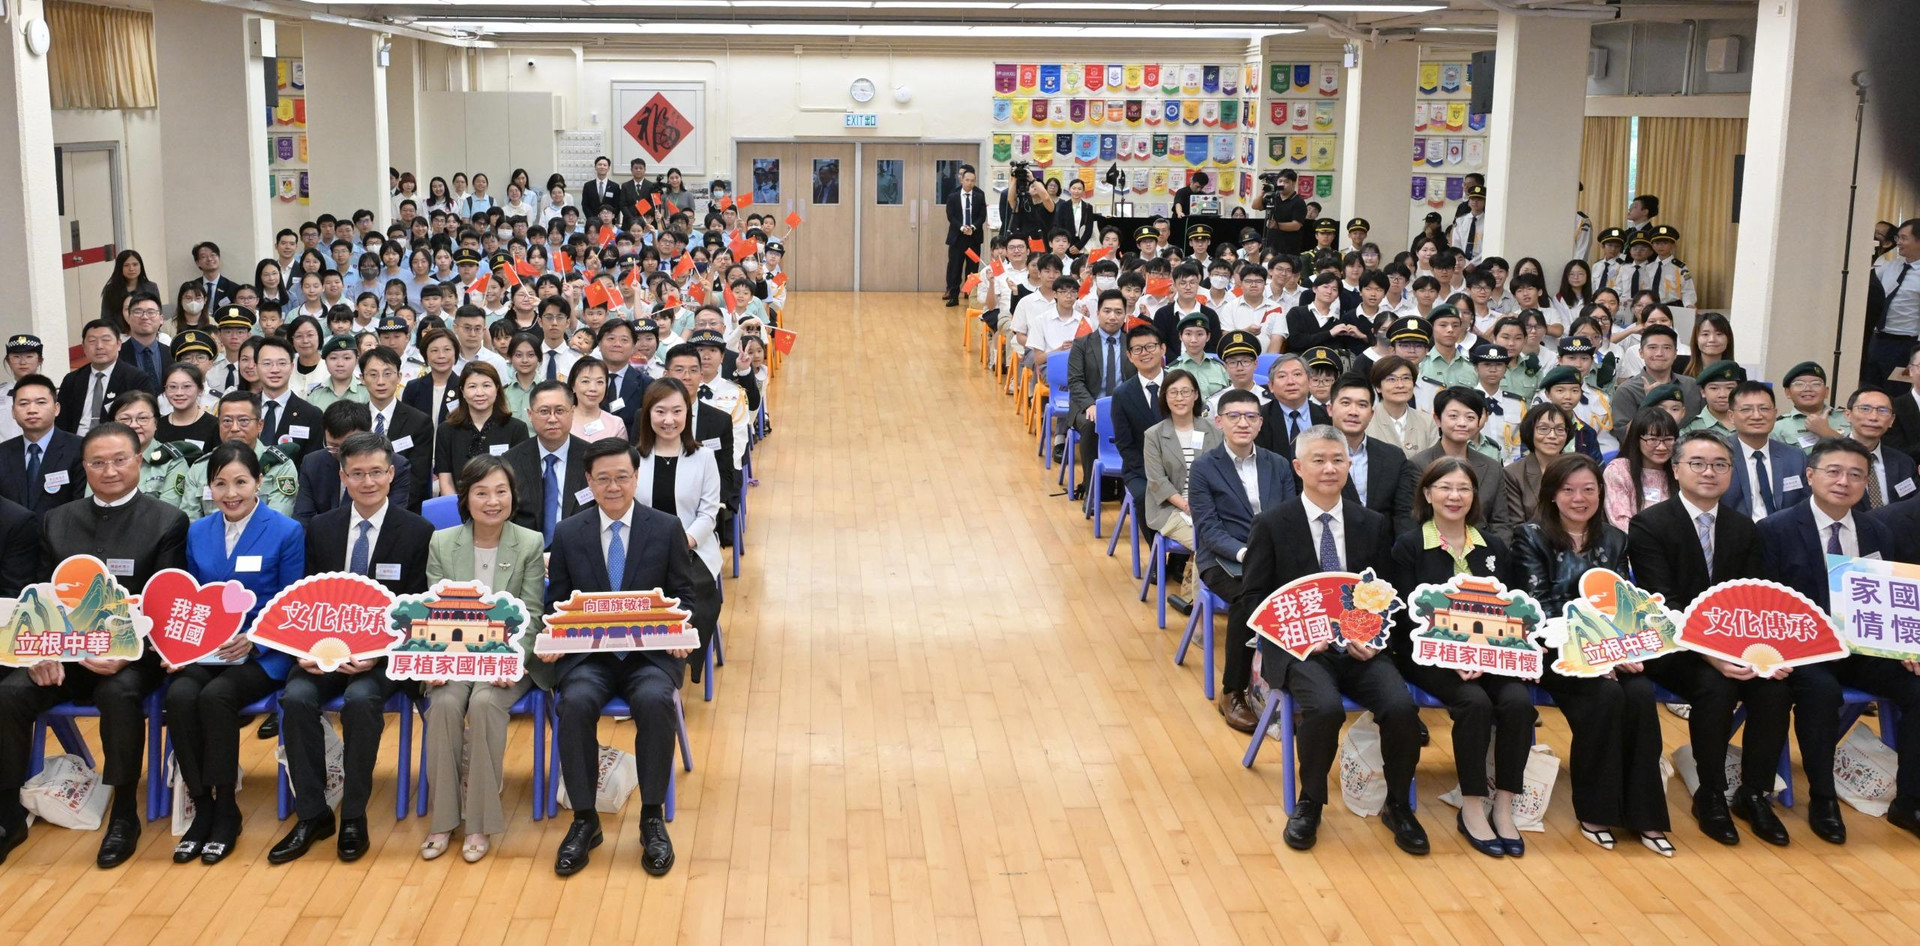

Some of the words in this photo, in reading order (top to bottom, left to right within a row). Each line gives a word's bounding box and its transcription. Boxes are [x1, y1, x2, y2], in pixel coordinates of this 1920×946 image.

[846, 115, 864, 126] EXIT
[865, 115, 876, 126] 出口
[584, 598, 651, 613] 向國旗敬禮
[1272, 587, 1327, 622] 我愛
[1850, 576, 1920, 611] 家國
[171, 597, 212, 626] 我愛
[278, 601, 387, 635] 文化傳承
[1702, 607, 1818, 642] 文化傳承
[1852, 609, 1920, 645] 情懷
[15, 630, 111, 656] 立根中華
[164, 617, 206, 647] 祖國
[1278, 614, 1333, 649] 祖國
[1582, 629, 1663, 664] 立根中華
[392, 654, 519, 676] 厚植家國情懷
[1419, 640, 1538, 673] 厚植家國情懷
